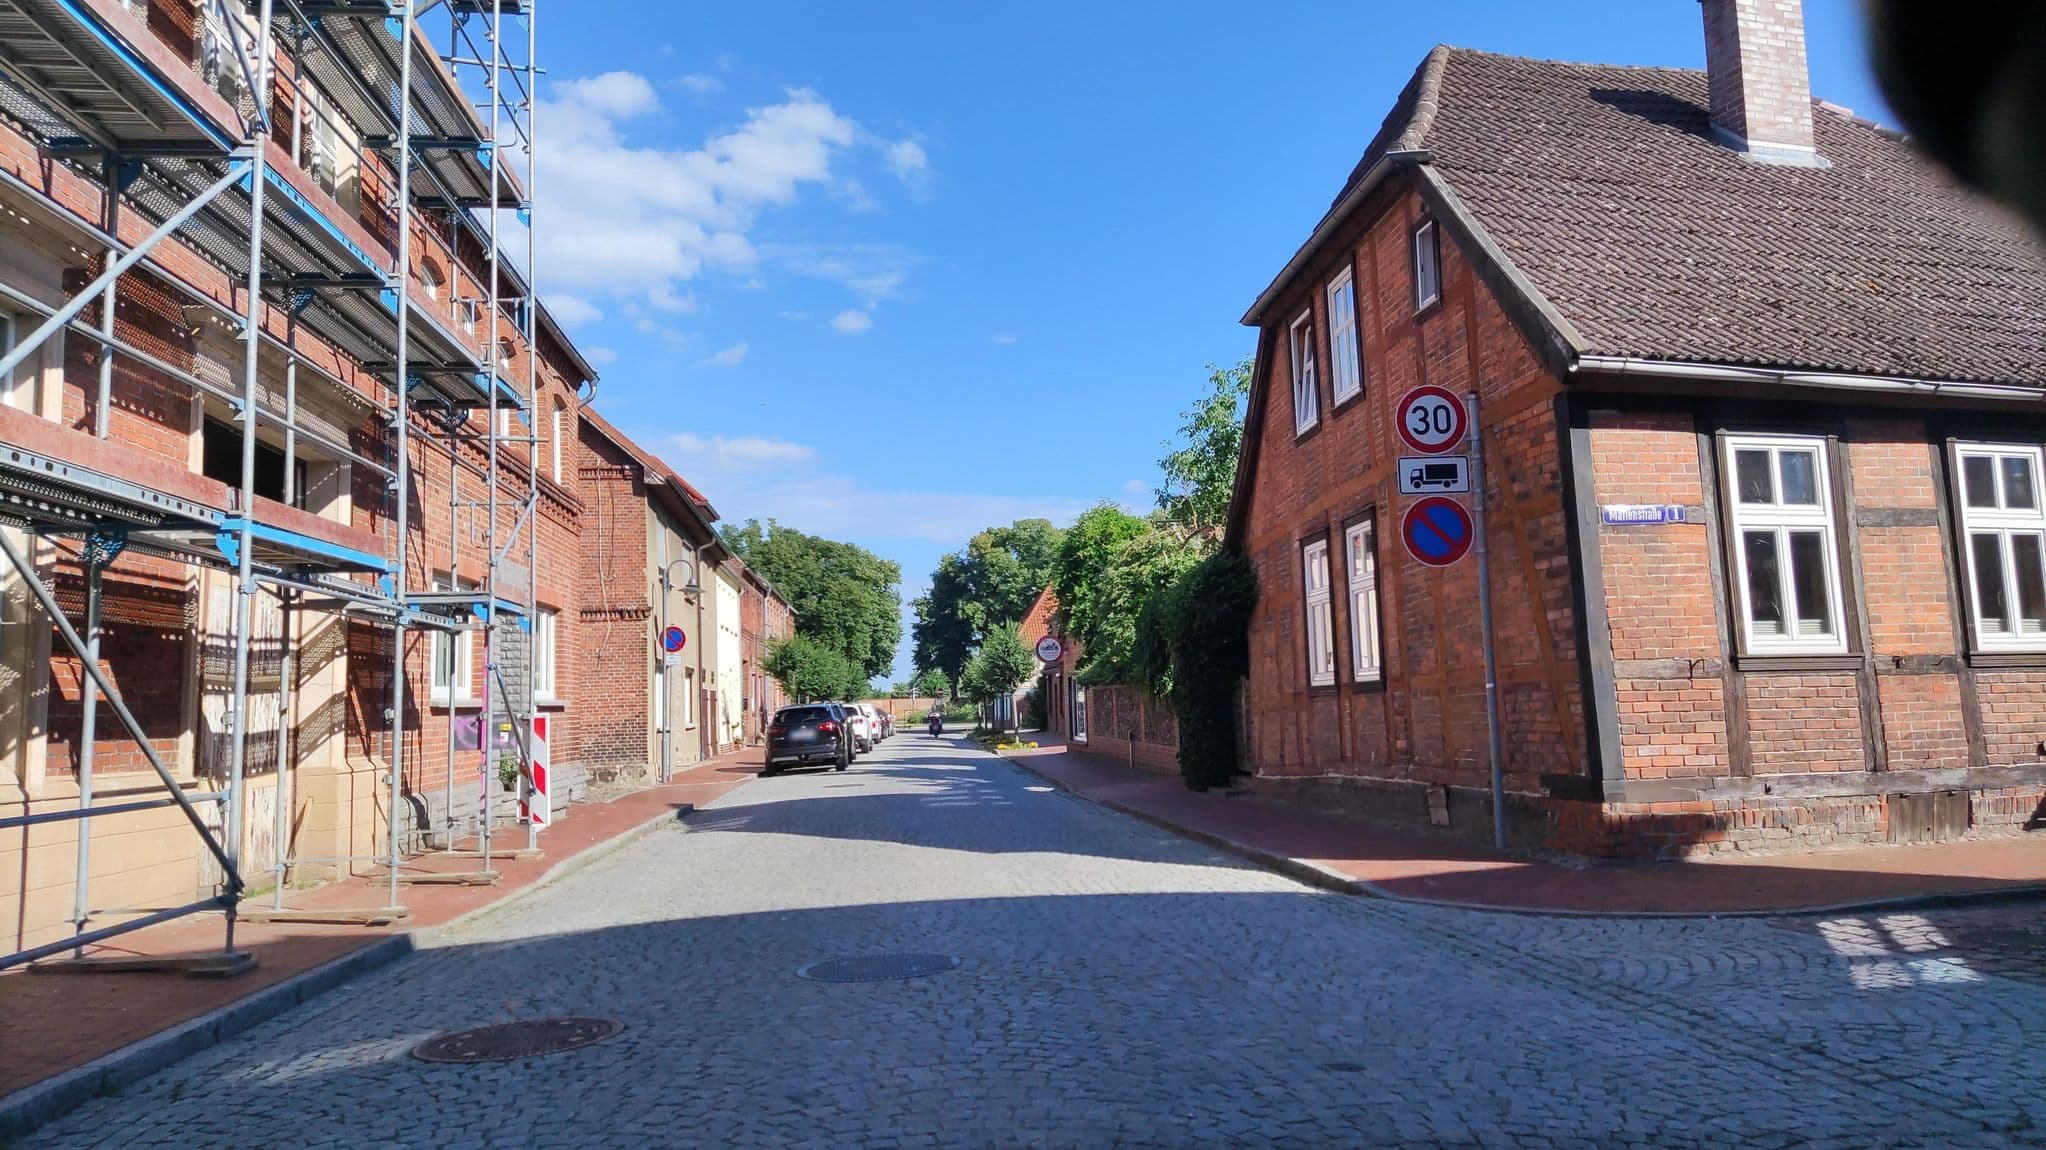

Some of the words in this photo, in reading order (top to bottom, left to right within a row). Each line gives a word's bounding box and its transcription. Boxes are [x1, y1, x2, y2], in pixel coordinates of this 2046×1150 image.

[1412, 404, 1451, 435] 30
[1609, 507, 1662, 521] Marienstraße
[1674, 508, 1679, 520] 1
